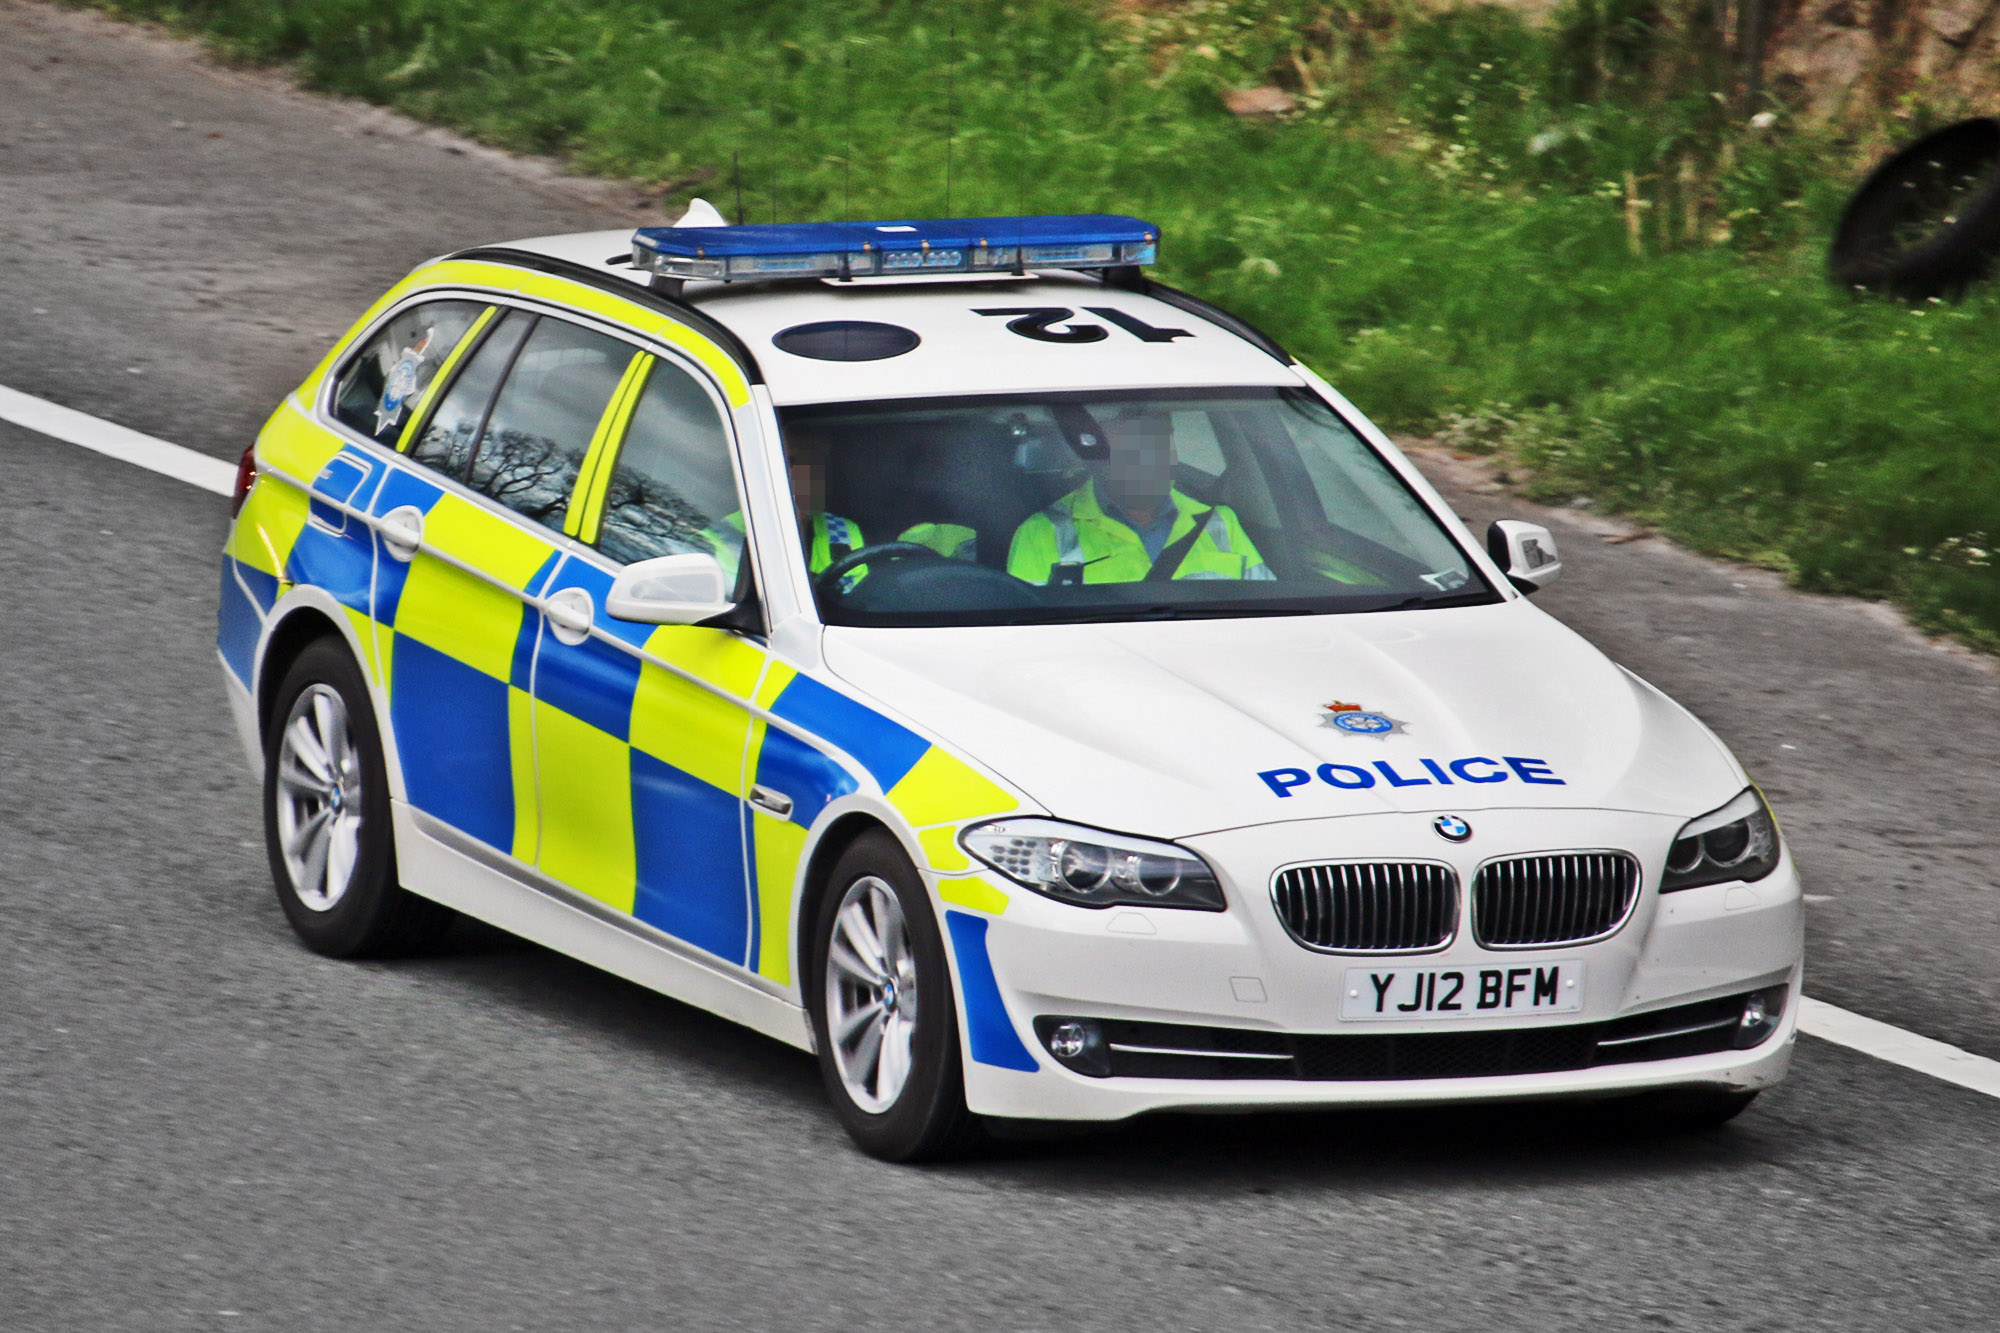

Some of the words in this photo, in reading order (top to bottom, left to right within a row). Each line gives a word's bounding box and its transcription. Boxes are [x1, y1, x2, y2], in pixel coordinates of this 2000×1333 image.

[969, 306, 1197, 343] 12
[1256, 756, 1567, 798] POLICE
[1370, 971, 1465, 1013] YJ12
[1476, 966, 1560, 1010] BFM
